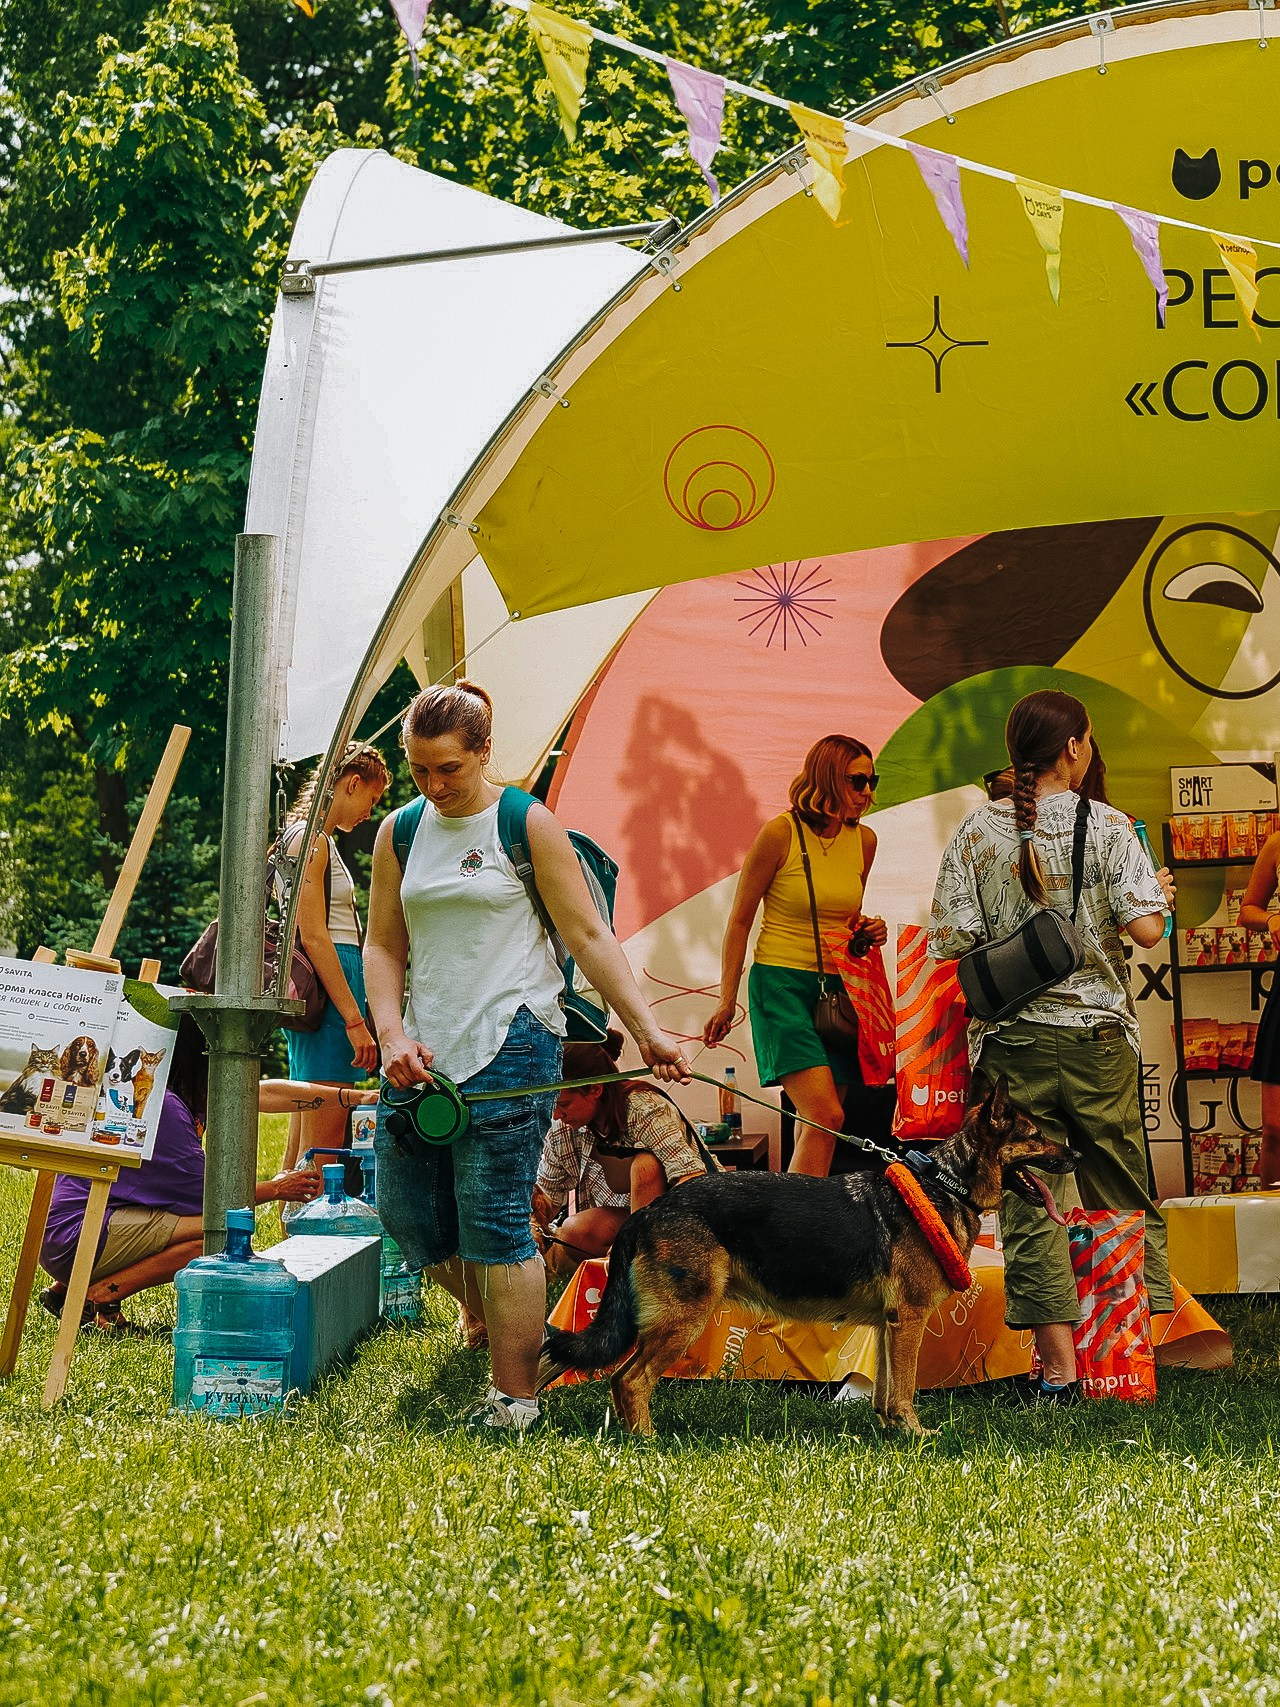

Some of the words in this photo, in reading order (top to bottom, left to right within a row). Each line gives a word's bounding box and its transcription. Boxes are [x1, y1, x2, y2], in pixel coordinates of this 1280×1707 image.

[1178, 776, 1213, 790] SMART
[1179, 787, 1214, 807] CAT
[4, 967, 33, 979] SAVITA
[0, 983, 26, 994] орма
[28, 988, 63, 1000] класса
[65, 992, 104, 1006] Holistic
[9, 996, 41, 1008] кошек
[53, 1003, 82, 1014] собак
[1142, 1063, 1161, 1132] NERO
[67, 1109, 86, 1117] SAVITA
[106, 1119, 127, 1127] Organix
[935, 1171, 969, 1196] JULIUS-K9
[966, 1283, 984, 1309] DAYS
[1082, 1373, 1140, 1394] hopru
